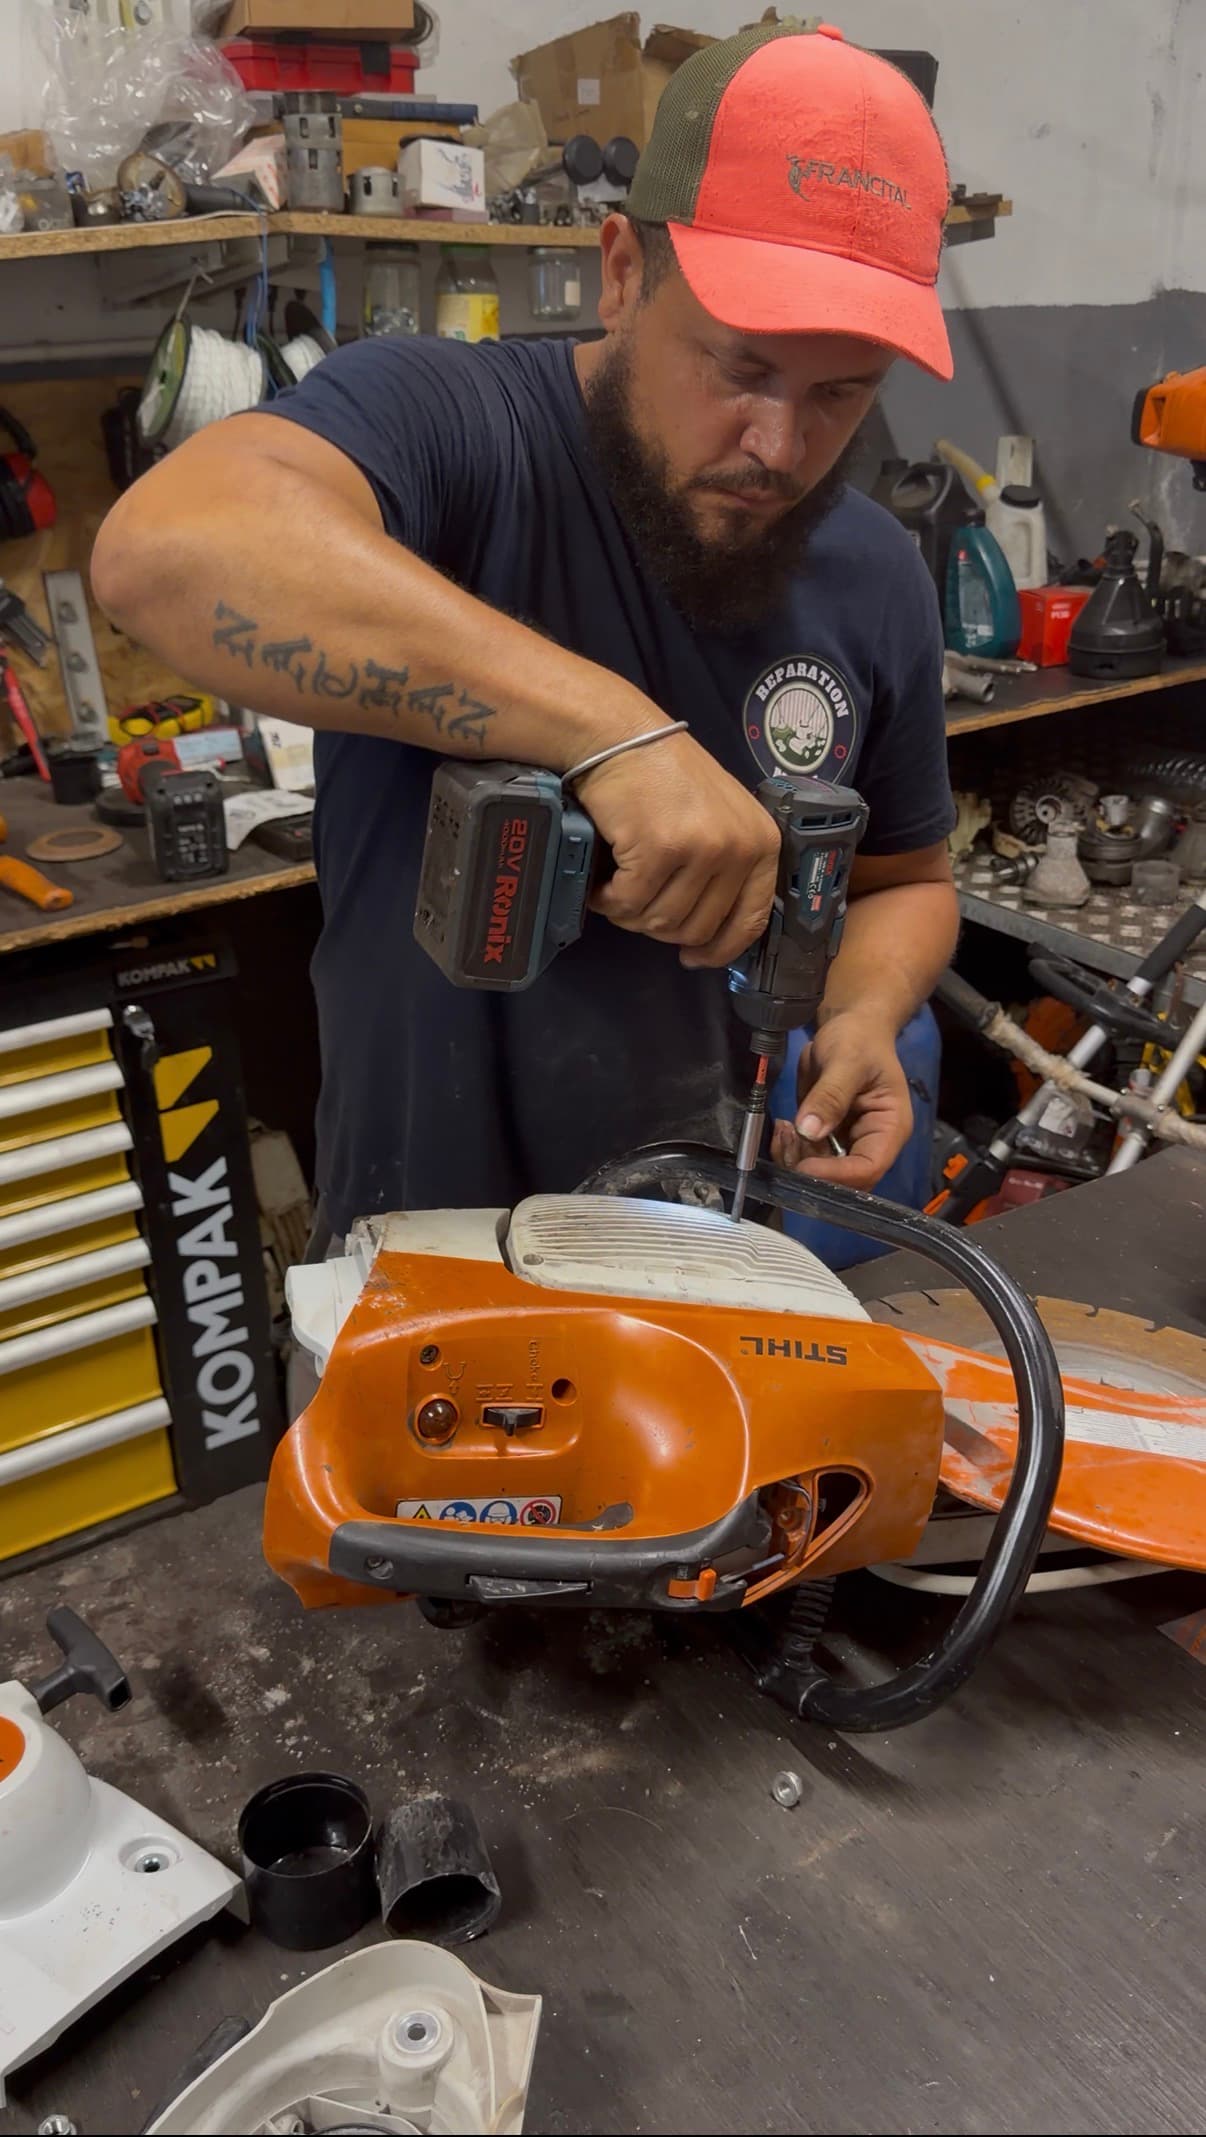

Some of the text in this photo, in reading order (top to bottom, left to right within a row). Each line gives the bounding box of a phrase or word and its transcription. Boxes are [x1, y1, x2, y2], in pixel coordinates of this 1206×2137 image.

[805, 159, 912, 210] FRANCITAL
[755, 662, 850, 718] REPARATION
[483, 818, 529, 964] 20V Ronix
[117, 959, 191, 988] KOMPAK
[168, 1156, 260, 1450] KOMPAK
[739, 1335, 848, 1366] STIHL
